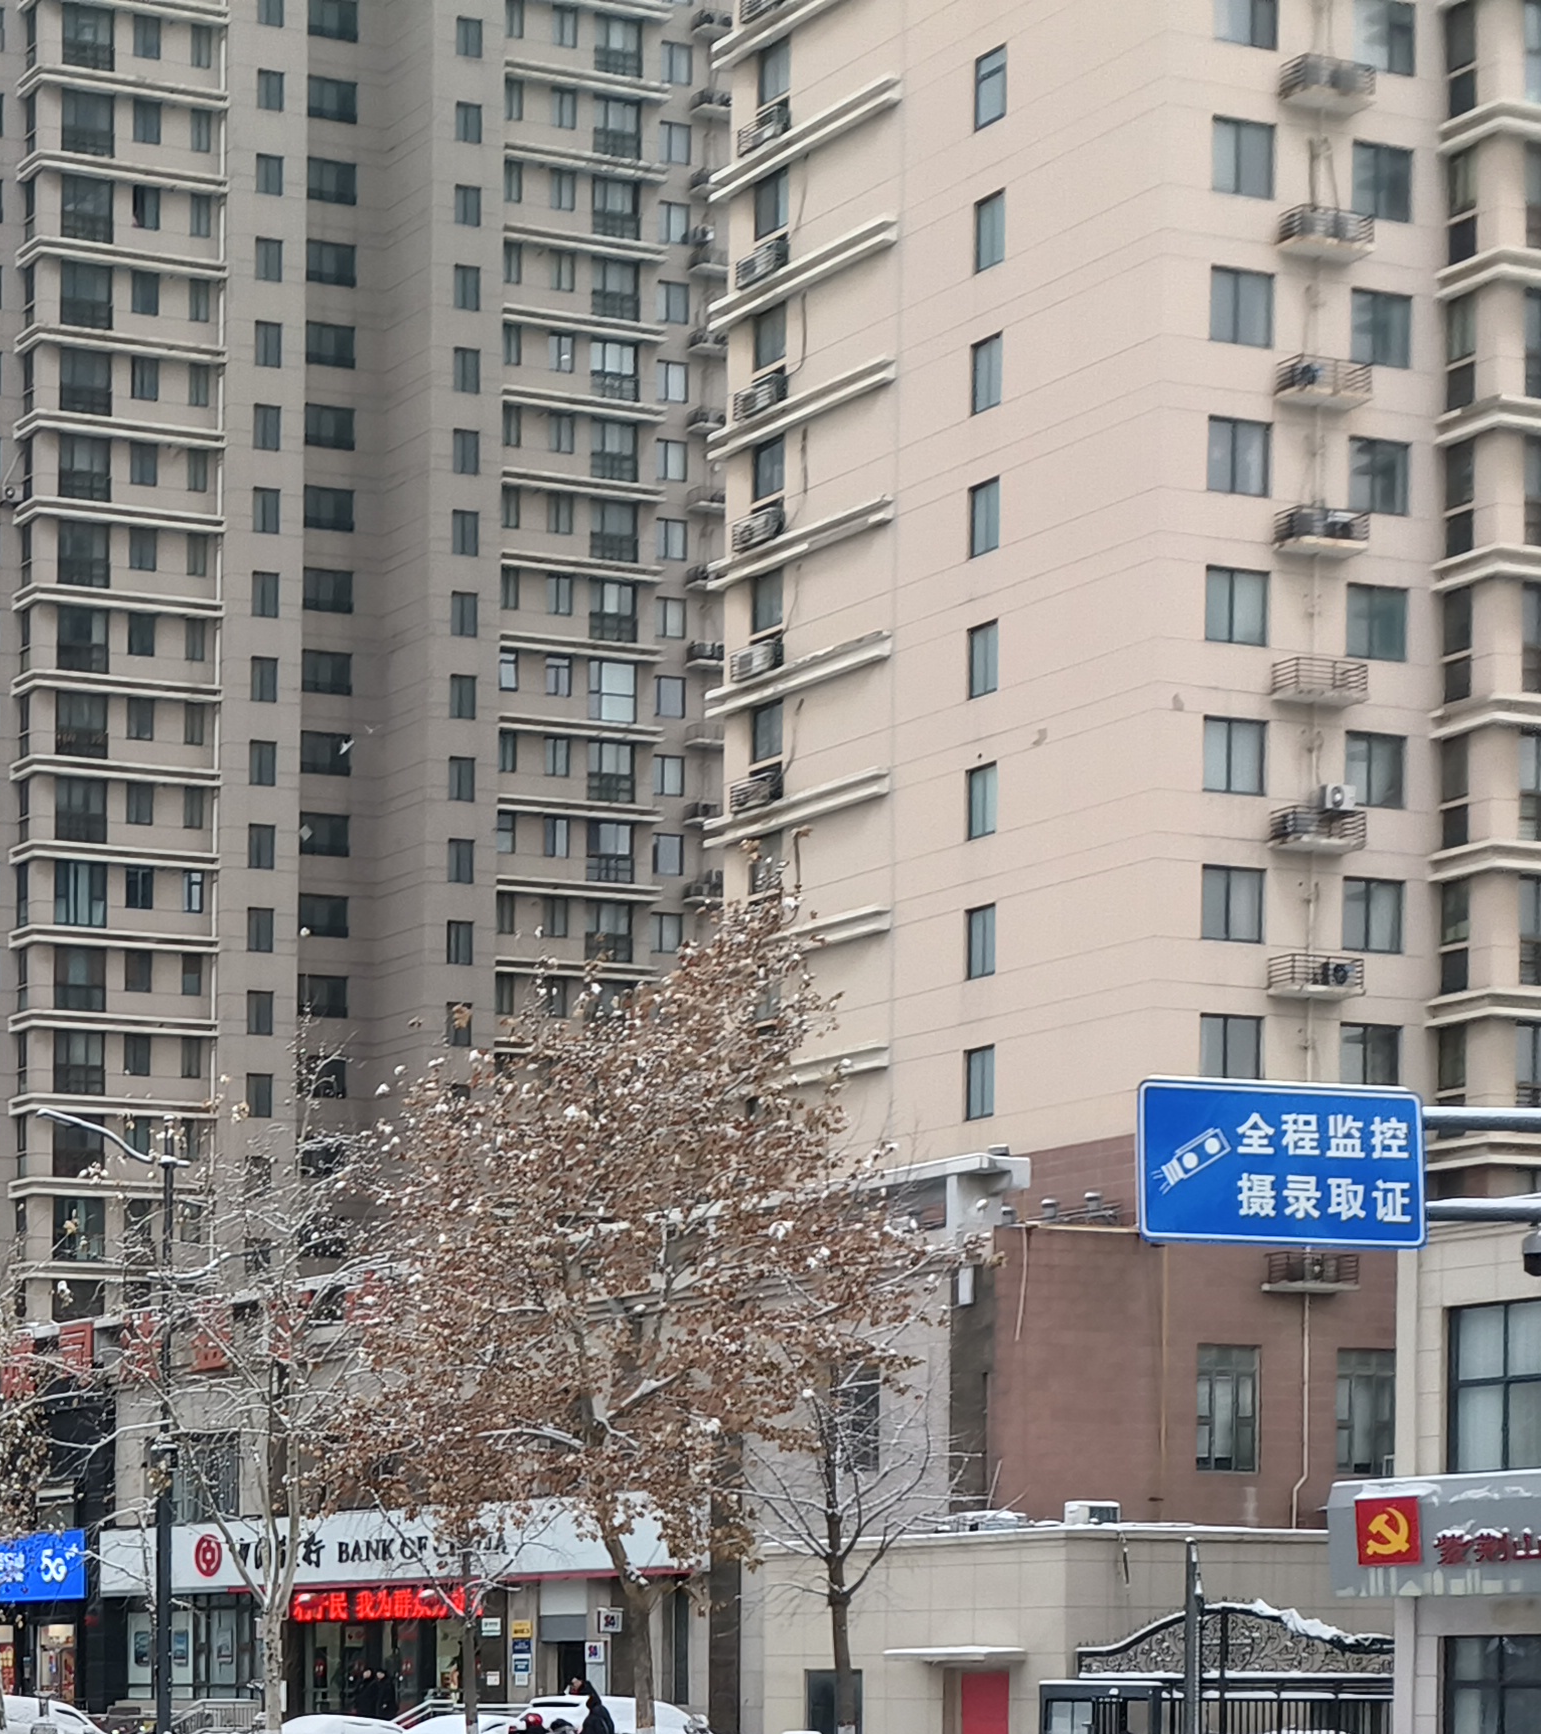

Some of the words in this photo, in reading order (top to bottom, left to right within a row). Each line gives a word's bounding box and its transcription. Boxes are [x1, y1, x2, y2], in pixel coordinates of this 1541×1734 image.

[1236, 1112, 1410, 1159] 全程监控
[1237, 1173, 1412, 1223] 摄录取证
[337, 1538, 395, 1563] BANK
[400, 1536, 428, 1559] OF
[433, 1533, 509, 1558] CNA
